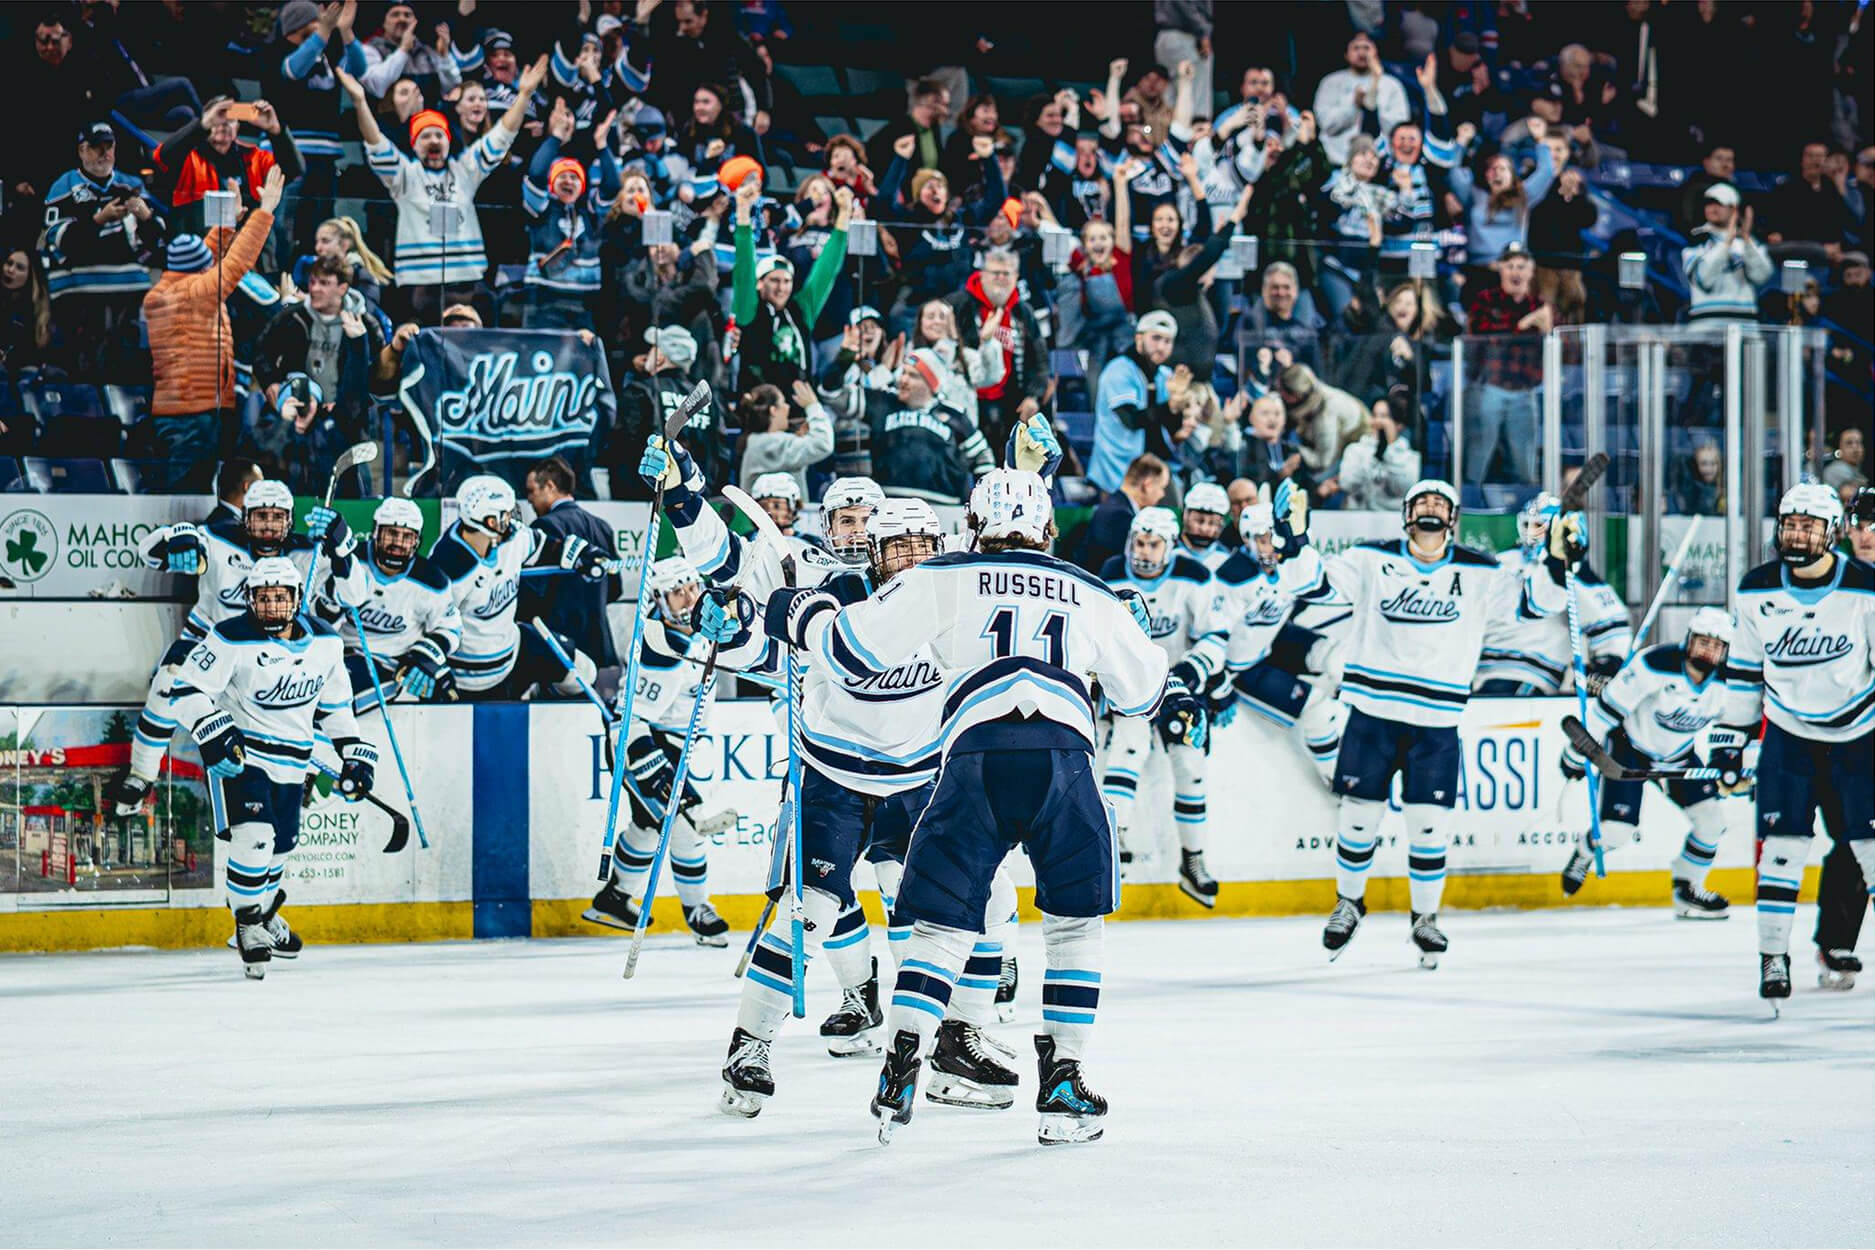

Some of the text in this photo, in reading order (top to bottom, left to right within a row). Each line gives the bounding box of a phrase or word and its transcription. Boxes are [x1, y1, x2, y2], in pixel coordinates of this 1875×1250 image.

[67, 523, 155, 546] MAHO
[67, 549, 98, 567] OIL
[978, 571, 1080, 606] RUSSELL
[1449, 571, 1462, 596] A
[1380, 586, 1460, 617] Maine
[979, 605, 1070, 670] 11
[1764, 626, 1853, 657] Maine
[191, 644, 217, 672] 28
[255, 672, 324, 702] Maine
[297, 832, 359, 847] OMPANY
